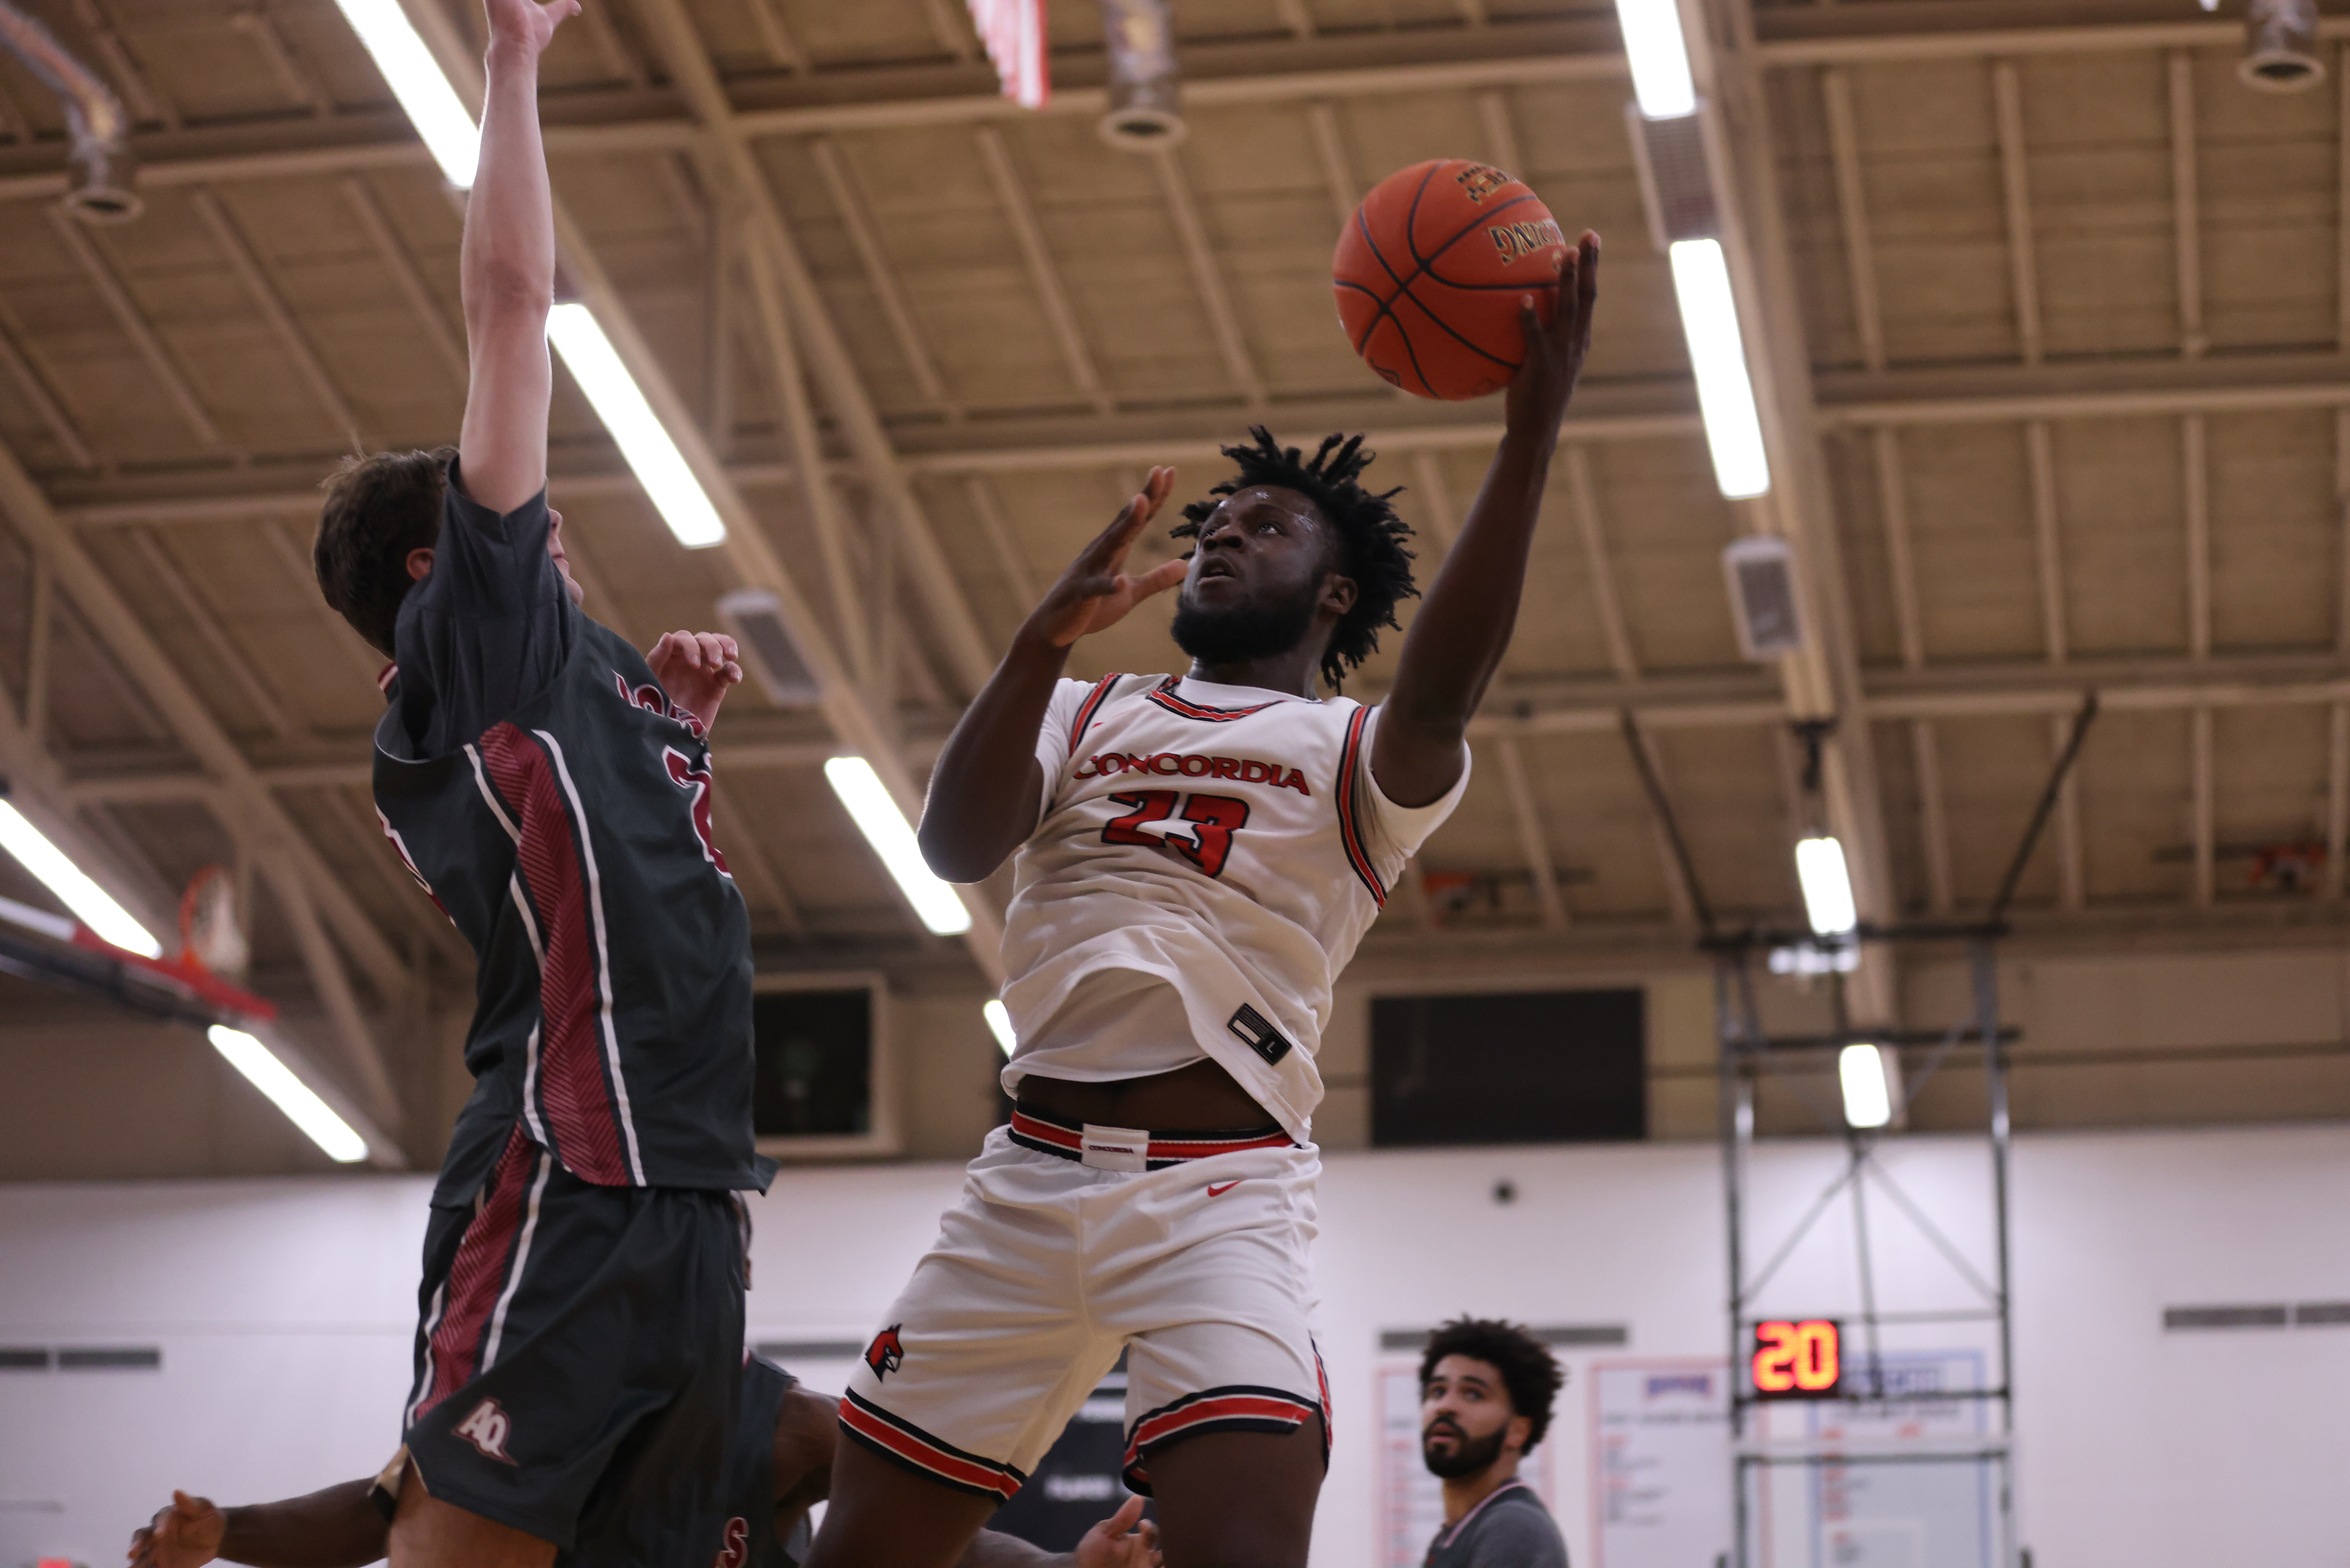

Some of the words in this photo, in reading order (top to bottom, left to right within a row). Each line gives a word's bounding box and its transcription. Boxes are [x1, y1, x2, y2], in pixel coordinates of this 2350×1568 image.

[1073, 752, 1310, 796] CONCORDIA
[1101, 790, 1250, 878] 23
[1752, 1320, 1839, 1391] 20
